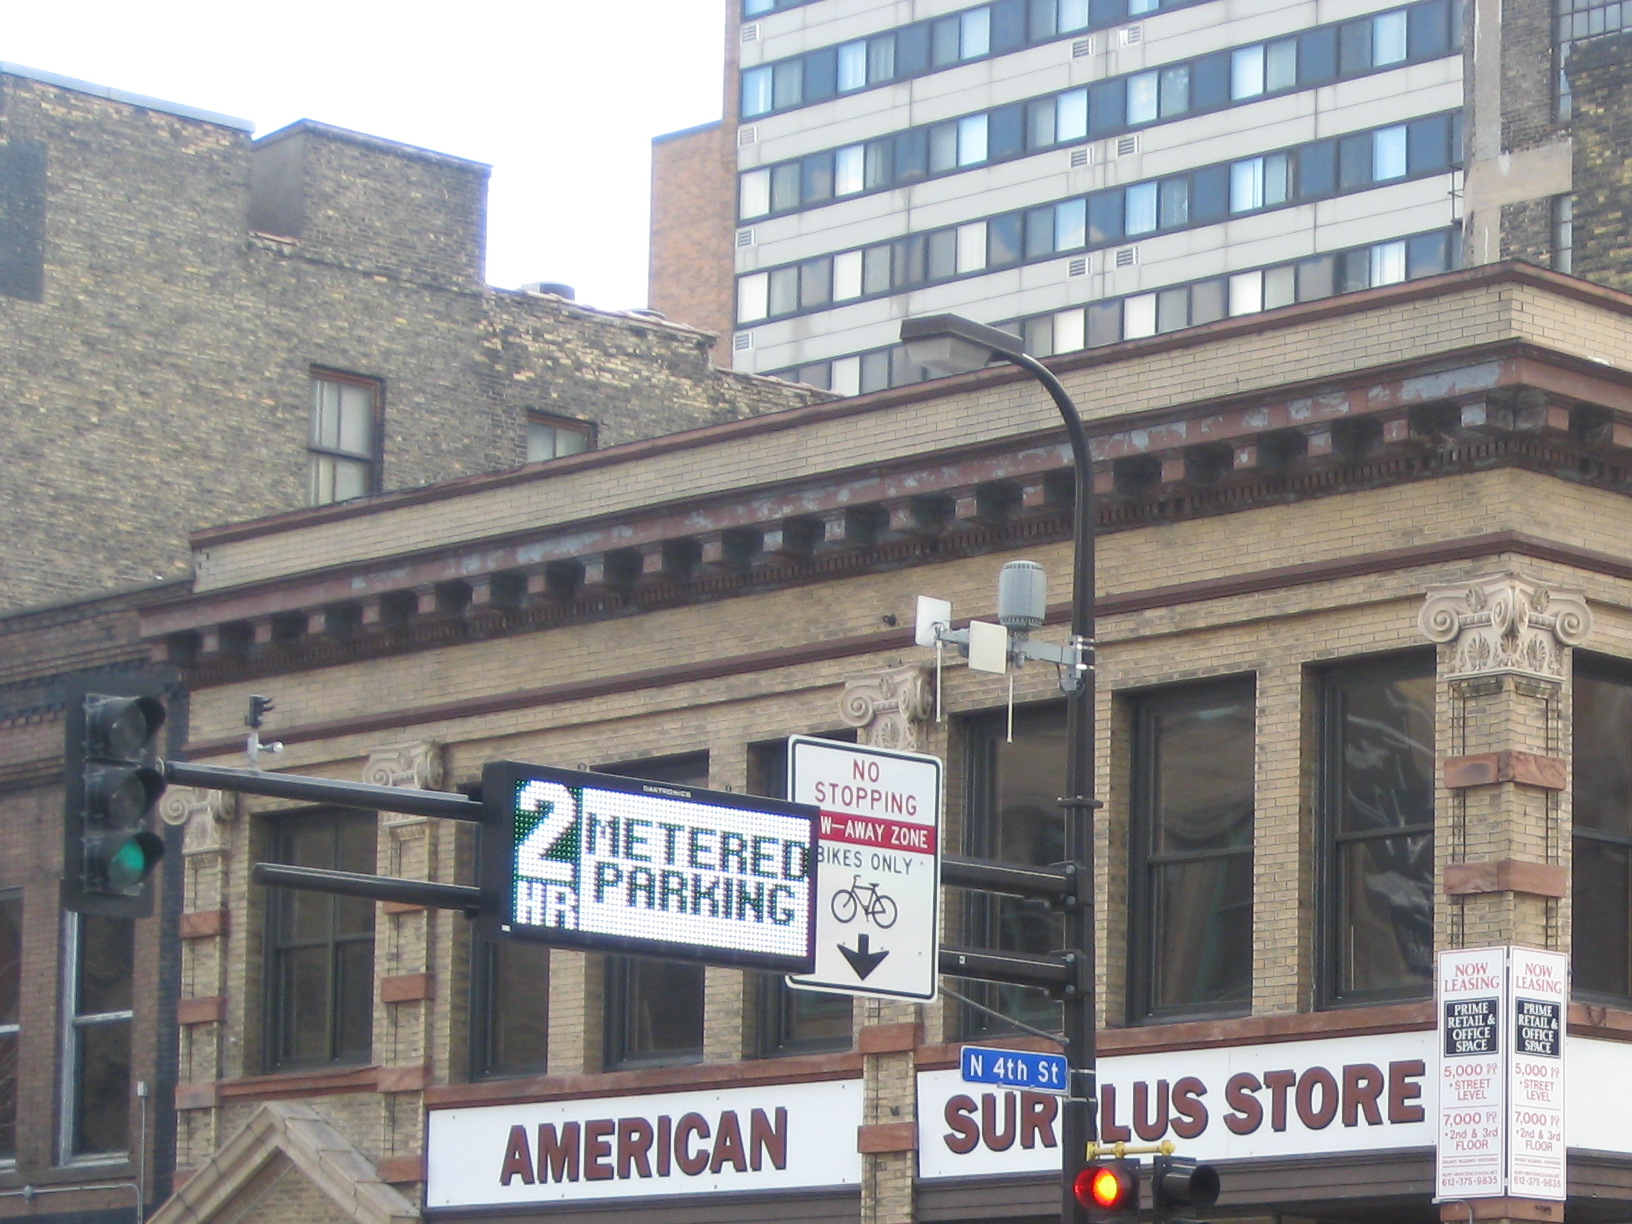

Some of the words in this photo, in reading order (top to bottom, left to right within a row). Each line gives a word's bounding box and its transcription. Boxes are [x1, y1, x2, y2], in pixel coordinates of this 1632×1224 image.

[852, 759, 880, 783] NO
[814, 782, 918, 816] STOPPING
[514, 779, 578, 881] 2
[890, 824, 928, 849] ZONE
[585, 811, 809, 882] METERED
[817, 845, 864, 868] BIKES
[871, 851, 913, 876] ONLY
[594, 860, 795, 926] PARKING
[514, 881, 579, 930] HR
[1455, 962, 1488, 977] NOW
[1525, 962, 1553, 978] NOW
[1444, 976, 1500, 992] LEASING
[1516, 975, 1562, 994] LEASING
[1454, 1002, 1489, 1015] PRIME
[1524, 1003, 1553, 1017] PRIME
[1447, 1015, 1485, 1028] RETAIL
[1487, 1013, 1496, 1025] &
[1518, 1014, 1549, 1029] RETAIL
[1550, 1018, 1559, 1030] &
[1452, 1027, 1491, 1041] OFFICE
[1522, 1027, 1554, 1042] OFFICE
[1455, 1039, 1488, 1053] SPACE
[1524, 1040, 1552, 1054] SPACE
[969, 1056, 983, 1076] N
[993, 1058, 1028, 1082] 4th
[1038, 1060, 1060, 1084] St
[1444, 1063, 1483, 1079] 5,000
[1515, 1062, 1547, 1078] 5,000
[1454, 1078, 1491, 1090] STREET
[1523, 1079, 1555, 1091] STREET
[1457, 1090, 1487, 1101] LEVEL
[1526, 1090, 1551, 1102] LEVEL
[943, 1076, 1209, 1156] SURLUS
[1223, 1058, 1426, 1136] STORE
[1443, 1112, 1482, 1128] 7,000
[1514, 1111, 1547, 1126] 7,000
[1449, 1128, 1467, 1140] 2nd
[1482, 1127, 1498, 1138] 3rd
[1520, 1128, 1535, 1139] 2nd
[499, 1106, 788, 1187] AMERICAN
[1455, 1140, 1488, 1151] FLOOR
[1525, 1140, 1553, 1152] FLOOR
